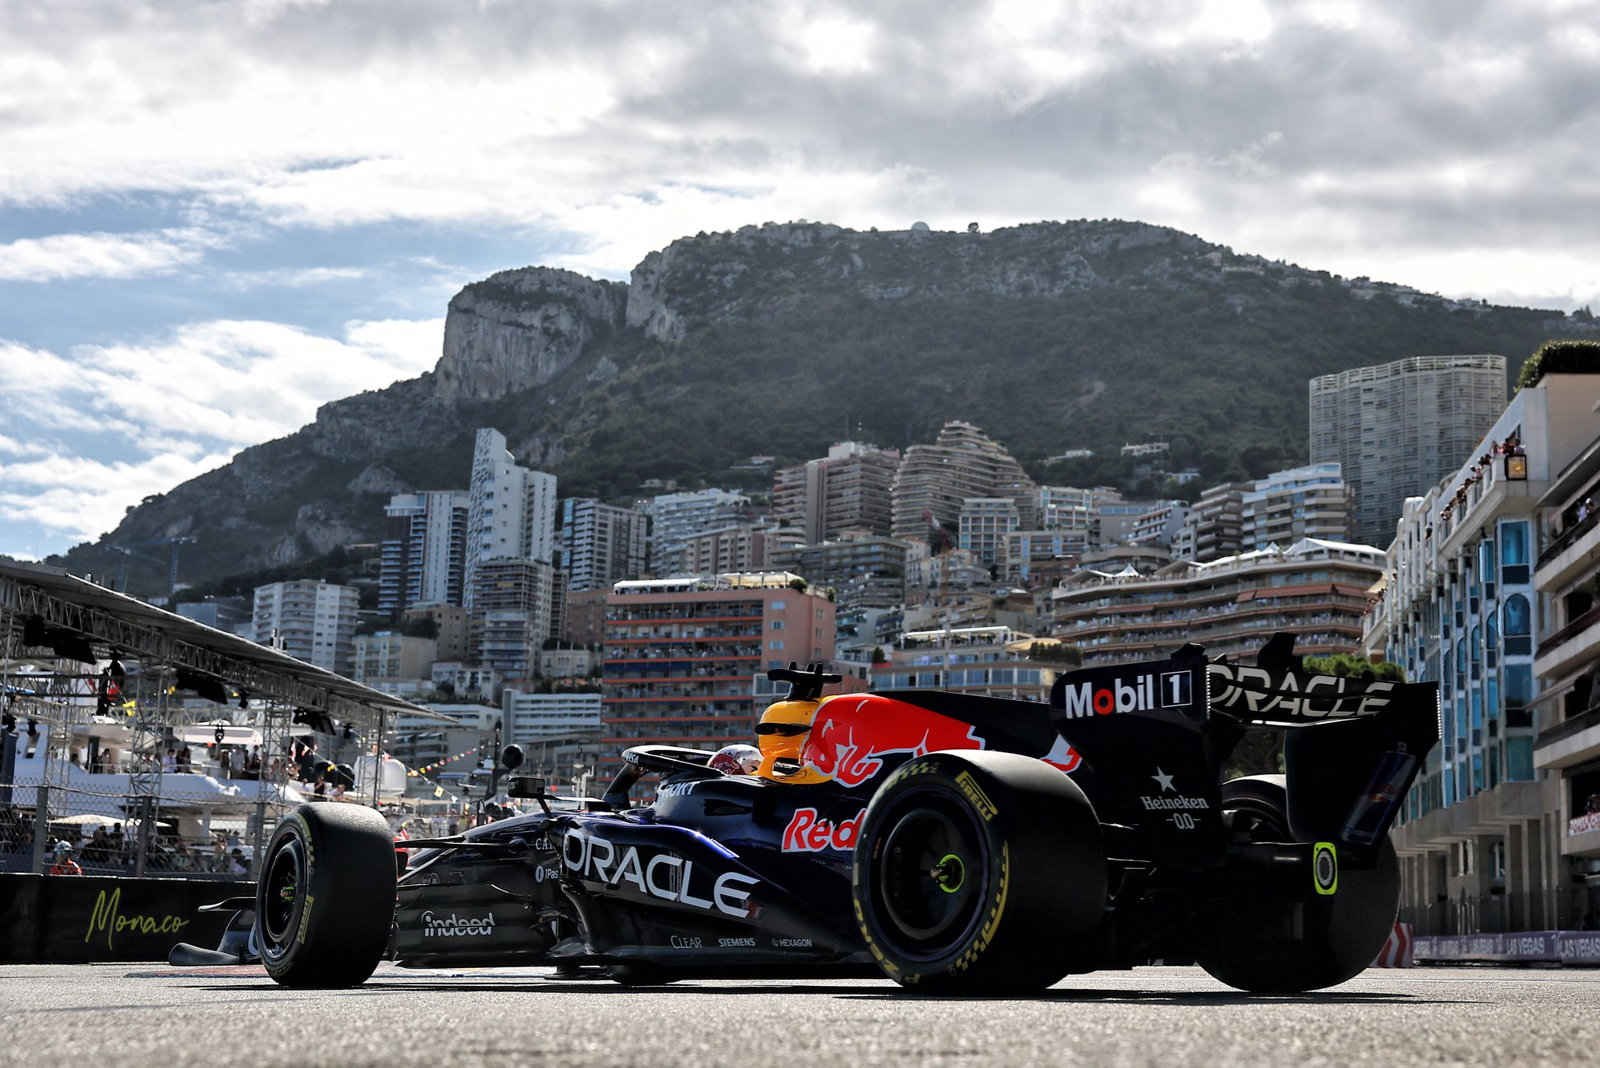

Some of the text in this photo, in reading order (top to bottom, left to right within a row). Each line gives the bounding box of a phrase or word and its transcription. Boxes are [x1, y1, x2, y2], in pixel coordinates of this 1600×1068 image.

[1065, 674, 1180, 719] Mobil 1
[1206, 663, 1395, 717] ORACLE
[955, 771, 998, 822] PIRELLI
[1139, 795, 1210, 810] Heineken
[781, 807, 866, 853] Red
[563, 827, 761, 918] ORACLE
[85, 887, 190, 951] Monaco
[421, 910, 496, 937] indeed
[670, 935, 703, 949] CLEAR
[718, 937, 756, 947] SIEMENS
[779, 938, 812, 947] HEXAGON
[1506, 938, 1518, 955] LAS
[1518, 936, 1545, 955] VEGAS
[1560, 938, 1575, 958] LAS
